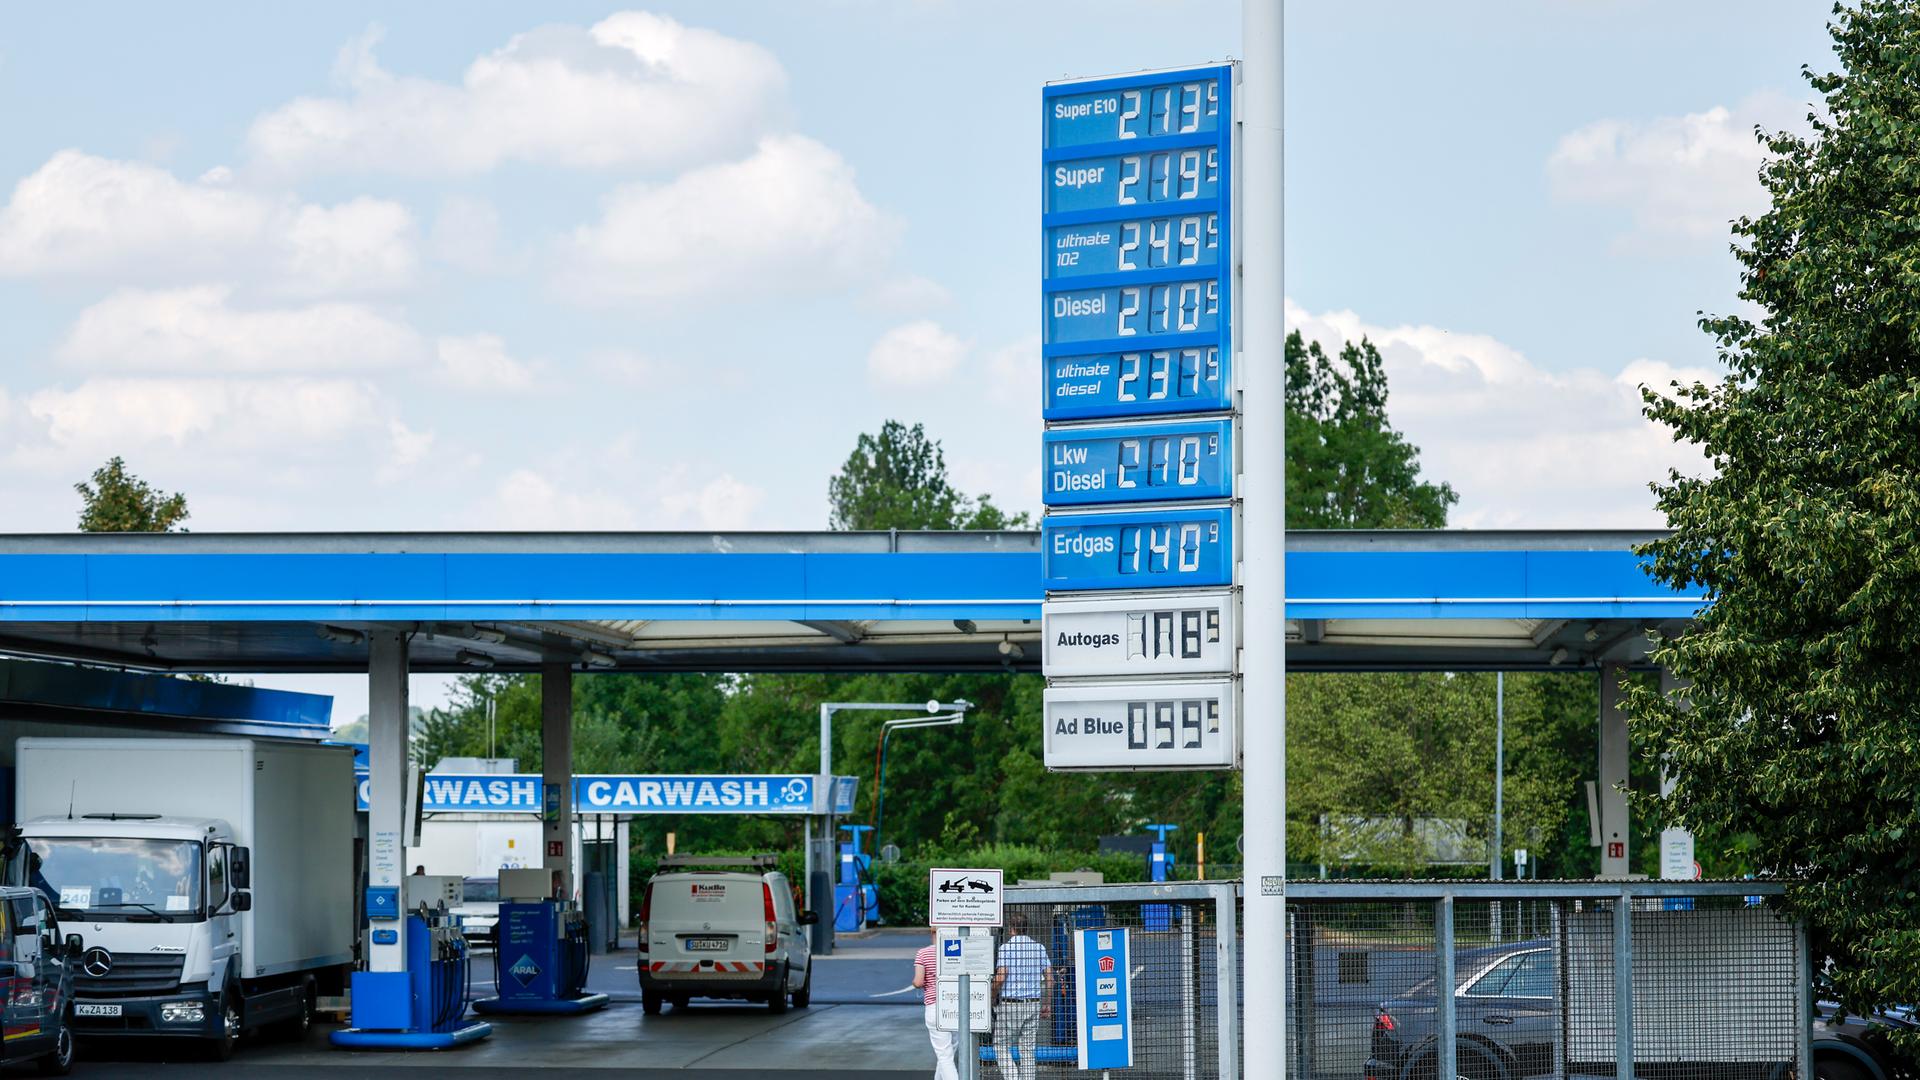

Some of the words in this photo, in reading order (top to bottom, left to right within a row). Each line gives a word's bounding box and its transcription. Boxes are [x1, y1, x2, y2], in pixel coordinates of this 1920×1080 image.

[1055, 102, 1092, 120] Super
[1094, 98, 1117, 115] E10
[1055, 167, 1105, 189] Super
[1056, 232, 1111, 249] ultimate
[1057, 251, 1080, 267] 102
[1054, 293, 1106, 318] Diesel
[1056, 362, 1110, 379] ultimate
[1056, 381, 1101, 397] diesel
[1053, 445, 1088, 465] Lkw
[1054, 468, 1106, 492] Diesel
[1054, 533, 1114, 557] Erdgas
[1057, 631, 1120, 648] Autogas
[1055, 718, 1078, 735] Ad
[1083, 717, 1124, 734] Blue
[588, 781, 768, 806] CARWASH
[61, 893, 89, 904] 240
[513, 966, 537, 975] ARAL
[102, 1005, 119, 1014] 138
